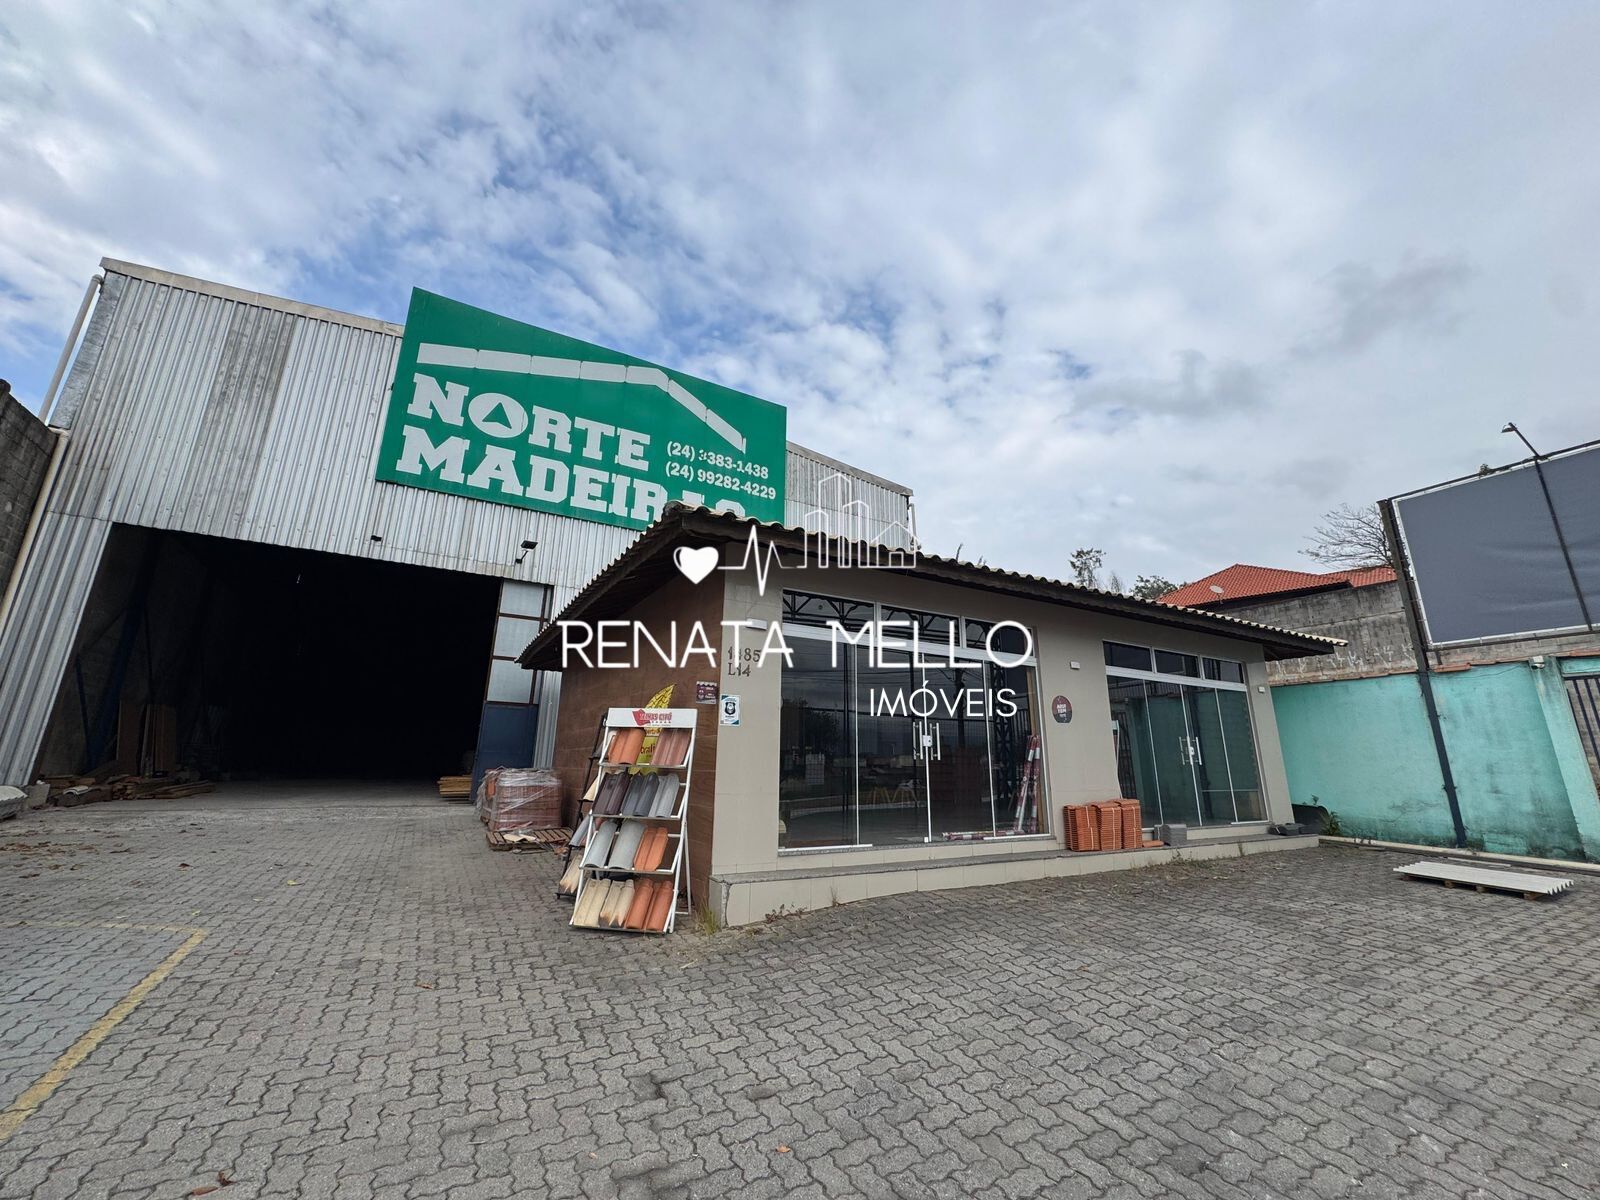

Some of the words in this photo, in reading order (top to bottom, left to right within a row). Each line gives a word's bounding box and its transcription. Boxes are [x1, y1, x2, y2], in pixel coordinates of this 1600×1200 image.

[407, 372, 651, 472] NORTE
[667, 440, 696, 462] (24)
[396, 424, 746, 523] MADEIR
[665, 460, 694, 482] (24)
[697, 469, 777, 500] 99282-4229
[727, 646, 762, 663] 185
[727, 662, 752, 677] L14
